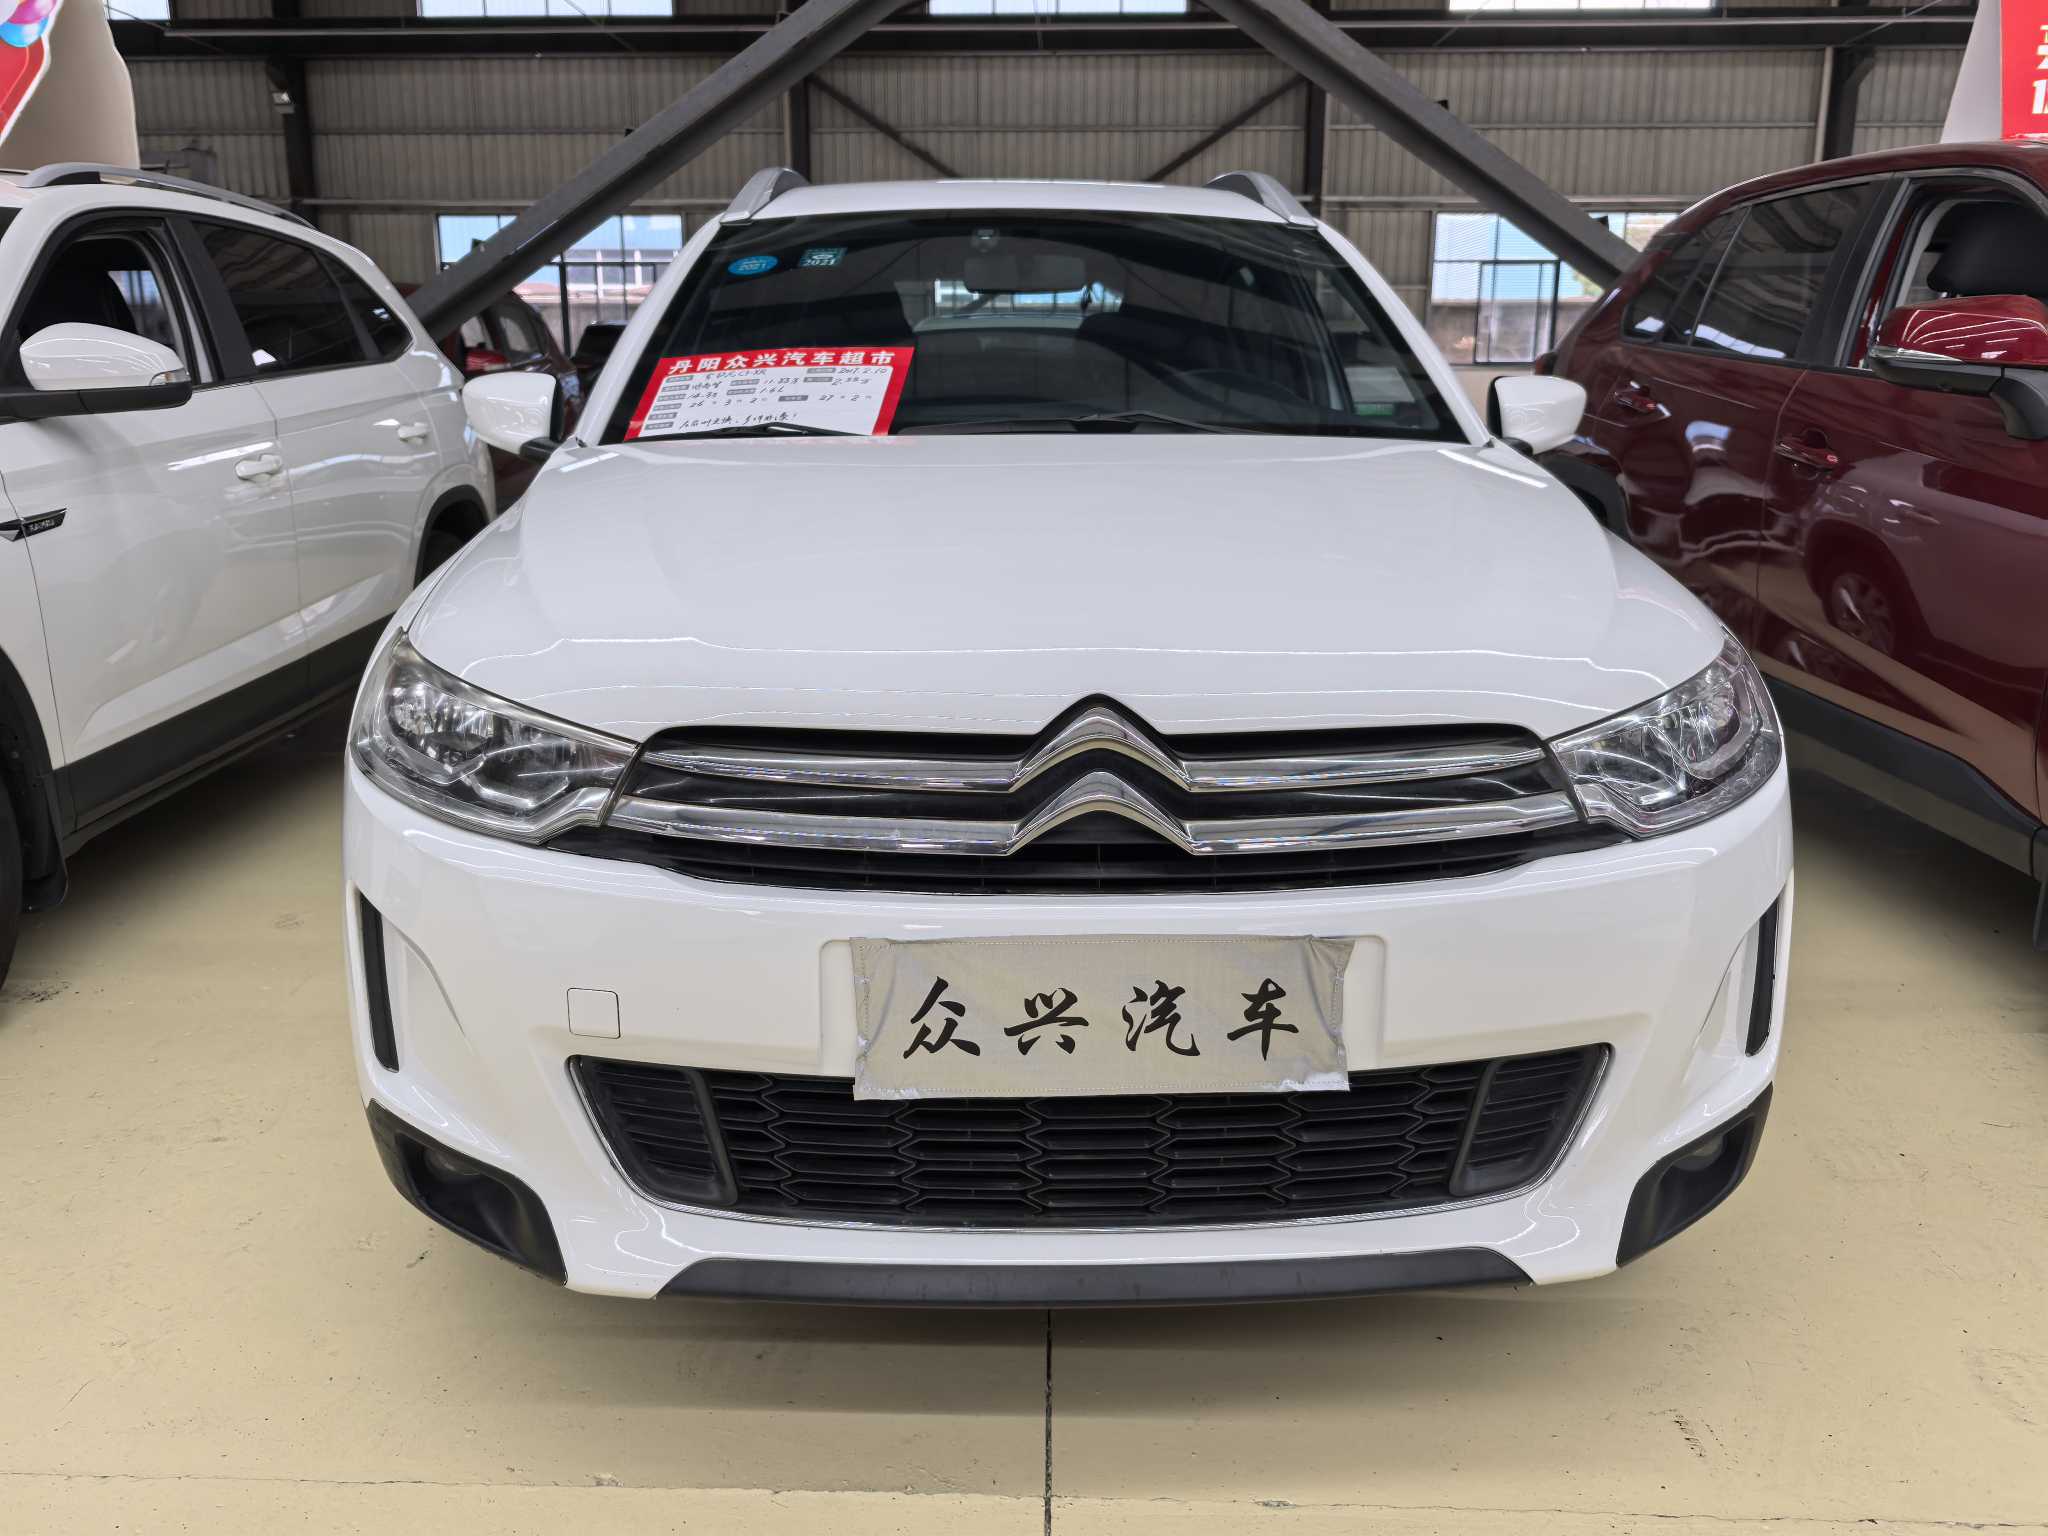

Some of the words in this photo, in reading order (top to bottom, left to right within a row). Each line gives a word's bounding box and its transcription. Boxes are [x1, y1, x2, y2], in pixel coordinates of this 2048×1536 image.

[667, 350, 896, 375] 丹阳众兴汽车超市
[903, 975, 1300, 1061] 众兴汽车
